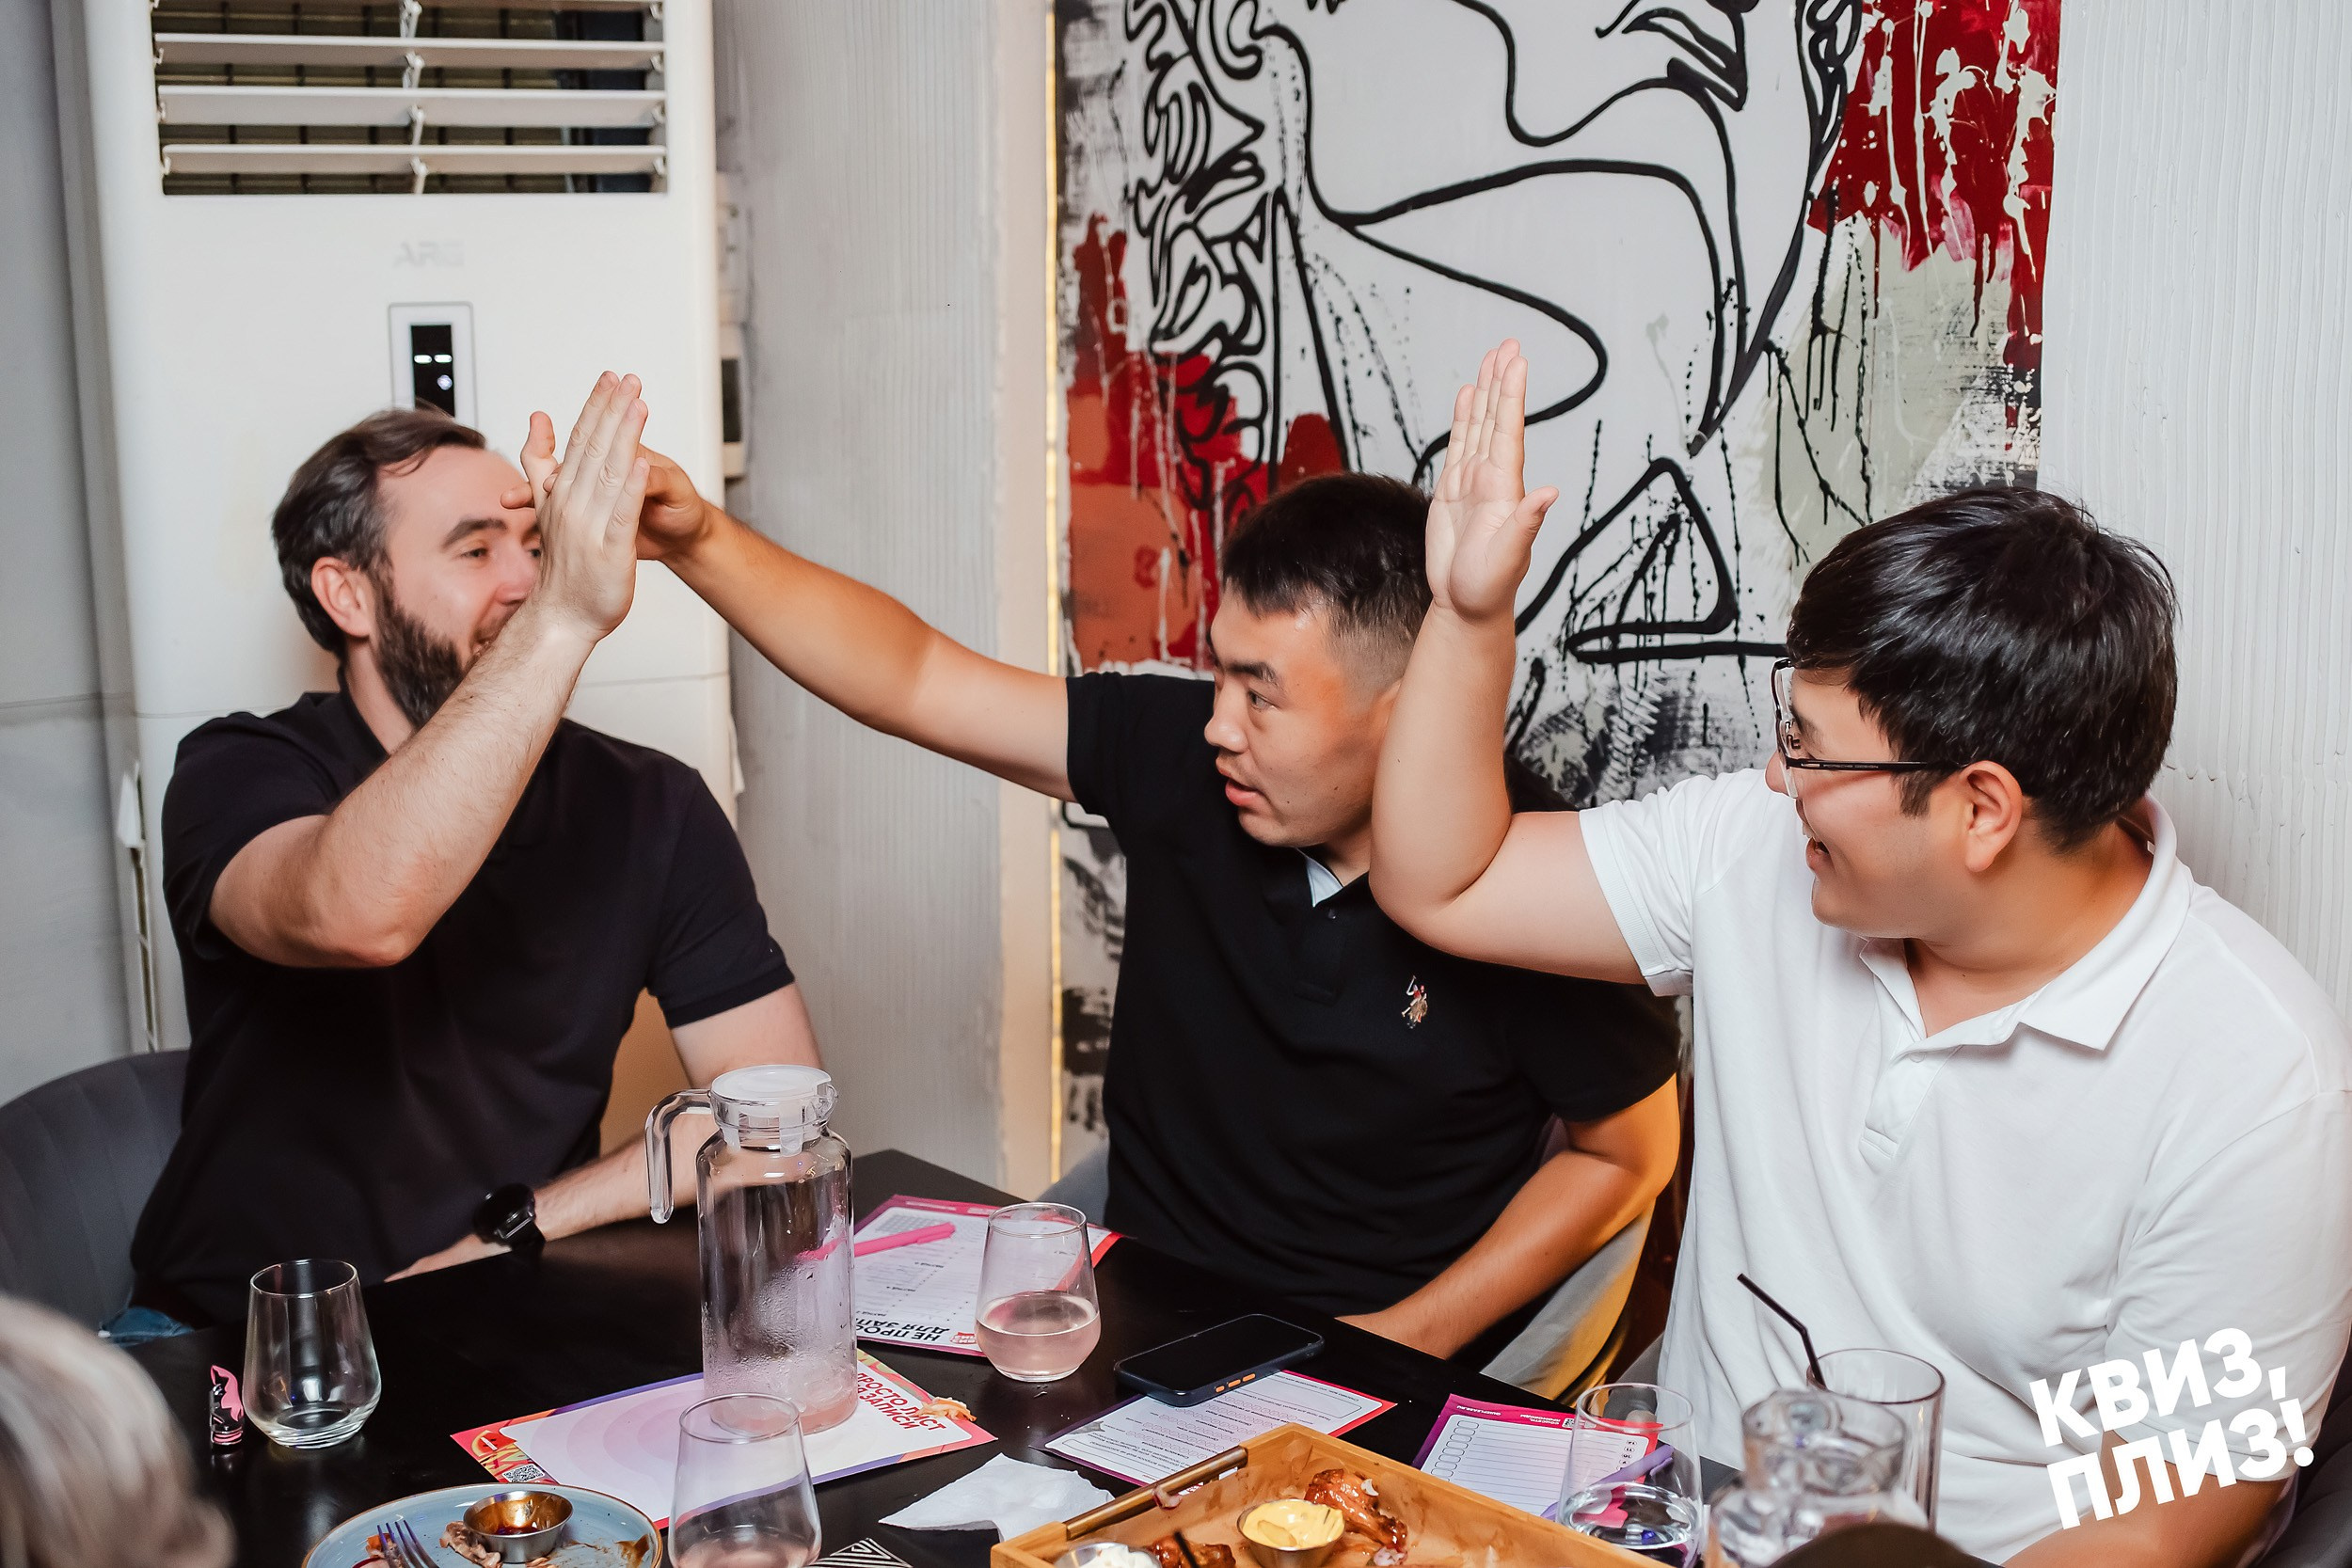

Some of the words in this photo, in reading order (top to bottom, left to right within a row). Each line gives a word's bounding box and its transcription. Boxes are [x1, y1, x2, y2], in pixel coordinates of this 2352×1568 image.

[856, 1318, 899, 1327] ЗАП
[901, 1323, 950, 1334] ДЛЯ
[912, 1331, 941, 1341] НЕ
[859, 1393, 920, 1430] ЗАПИСИ
